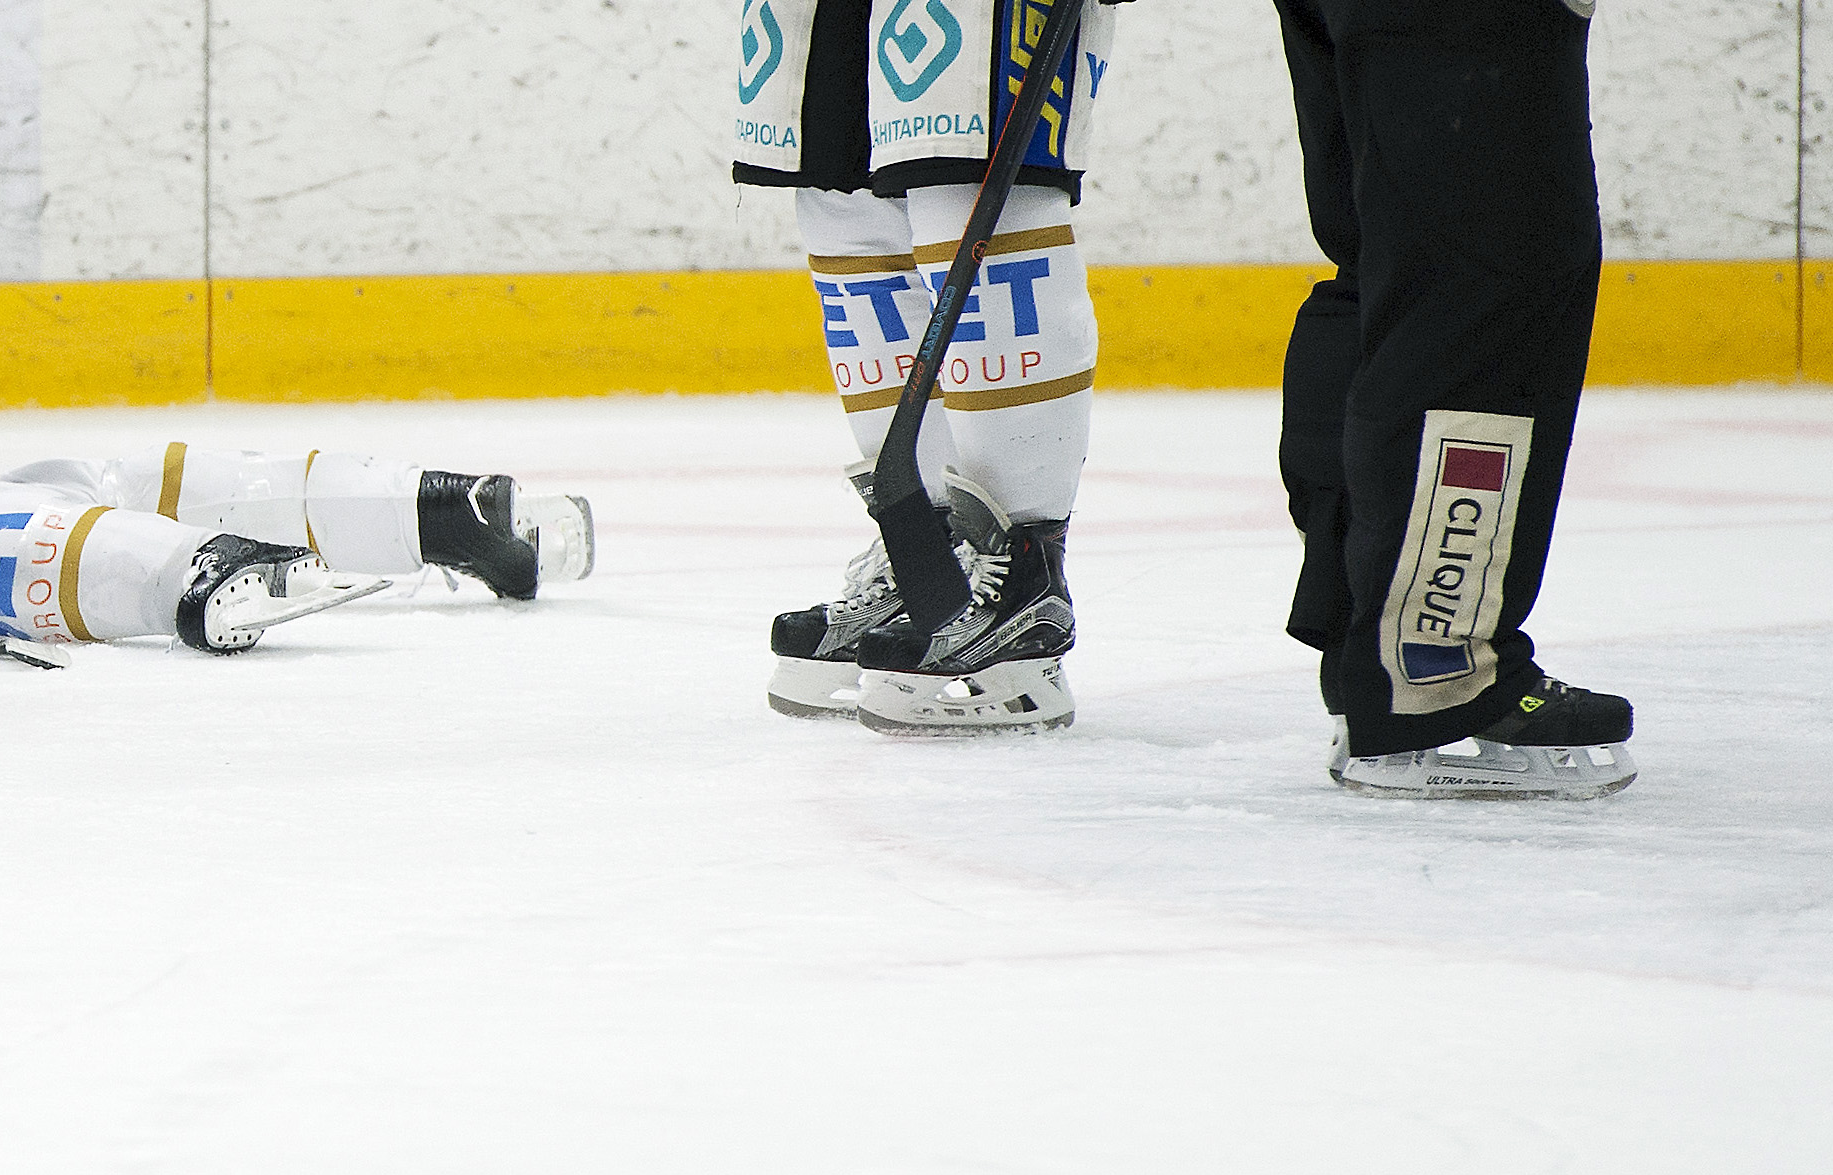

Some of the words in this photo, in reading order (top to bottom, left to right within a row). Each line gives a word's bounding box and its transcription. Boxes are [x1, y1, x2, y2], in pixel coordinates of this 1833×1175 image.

[872, 112, 986, 150] ÄHITAPIOLA
[814, 273, 911, 349] ET
[932, 256, 1051, 344] ET
[836, 354, 918, 389] OUP
[1415, 496, 1483, 640] CLIQUE
[1424, 774, 1464, 787] ULTRA
